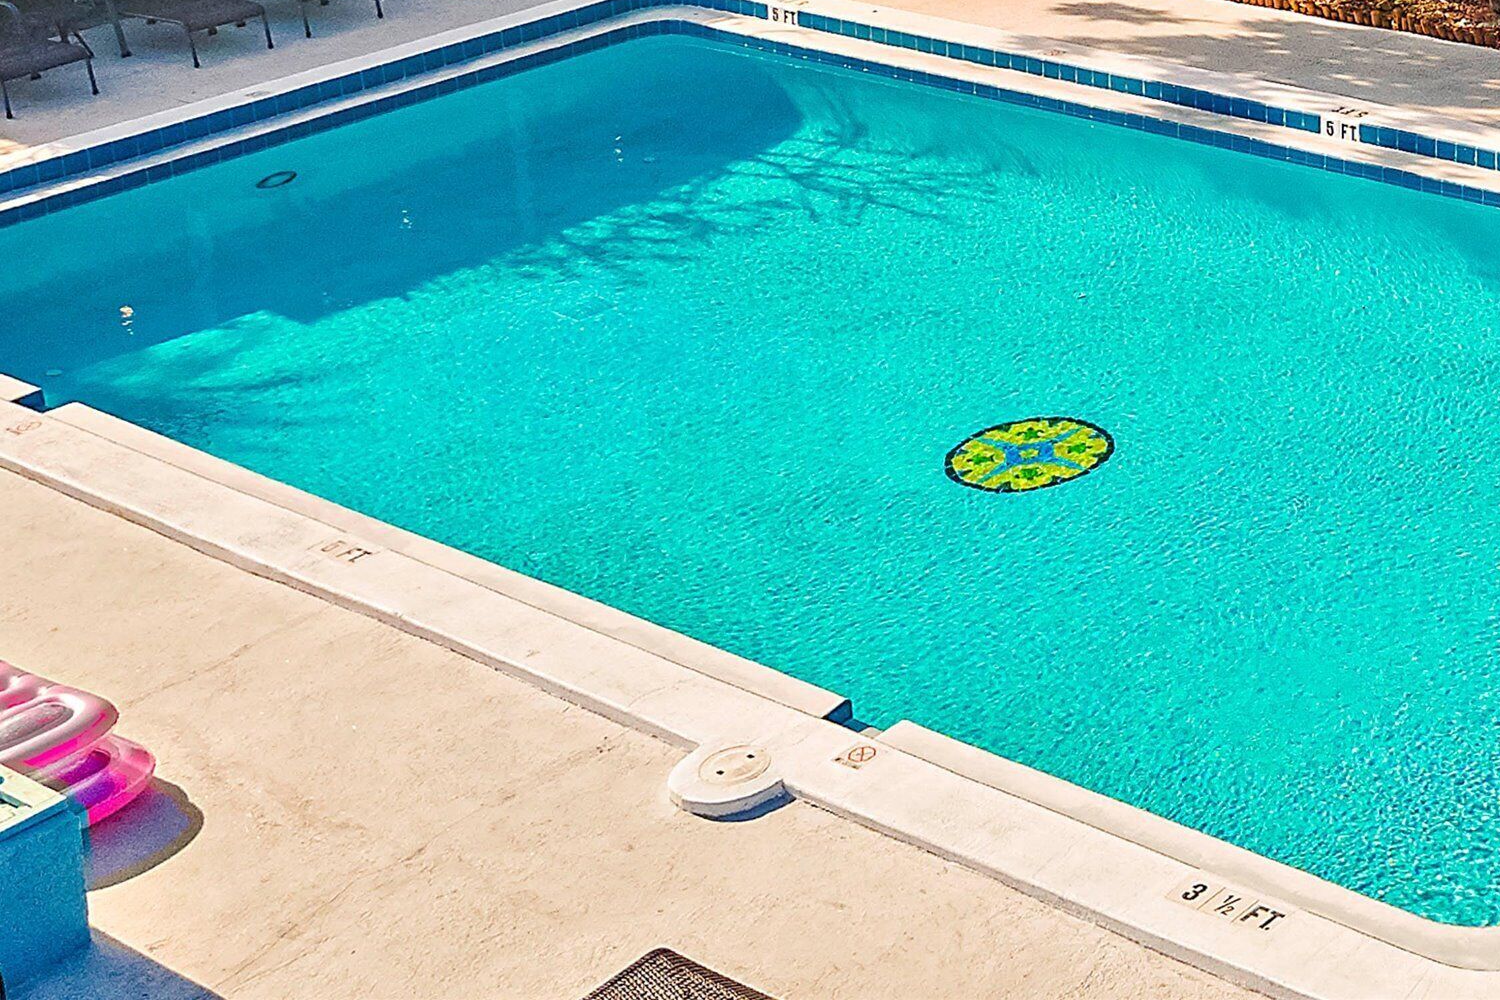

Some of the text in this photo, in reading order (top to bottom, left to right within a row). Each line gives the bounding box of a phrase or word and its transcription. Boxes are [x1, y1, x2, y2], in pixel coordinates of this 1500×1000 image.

[772, 7, 779, 22] 5
[1326, 120, 1334, 136] 5
[1181, 883, 1208, 901] 3
